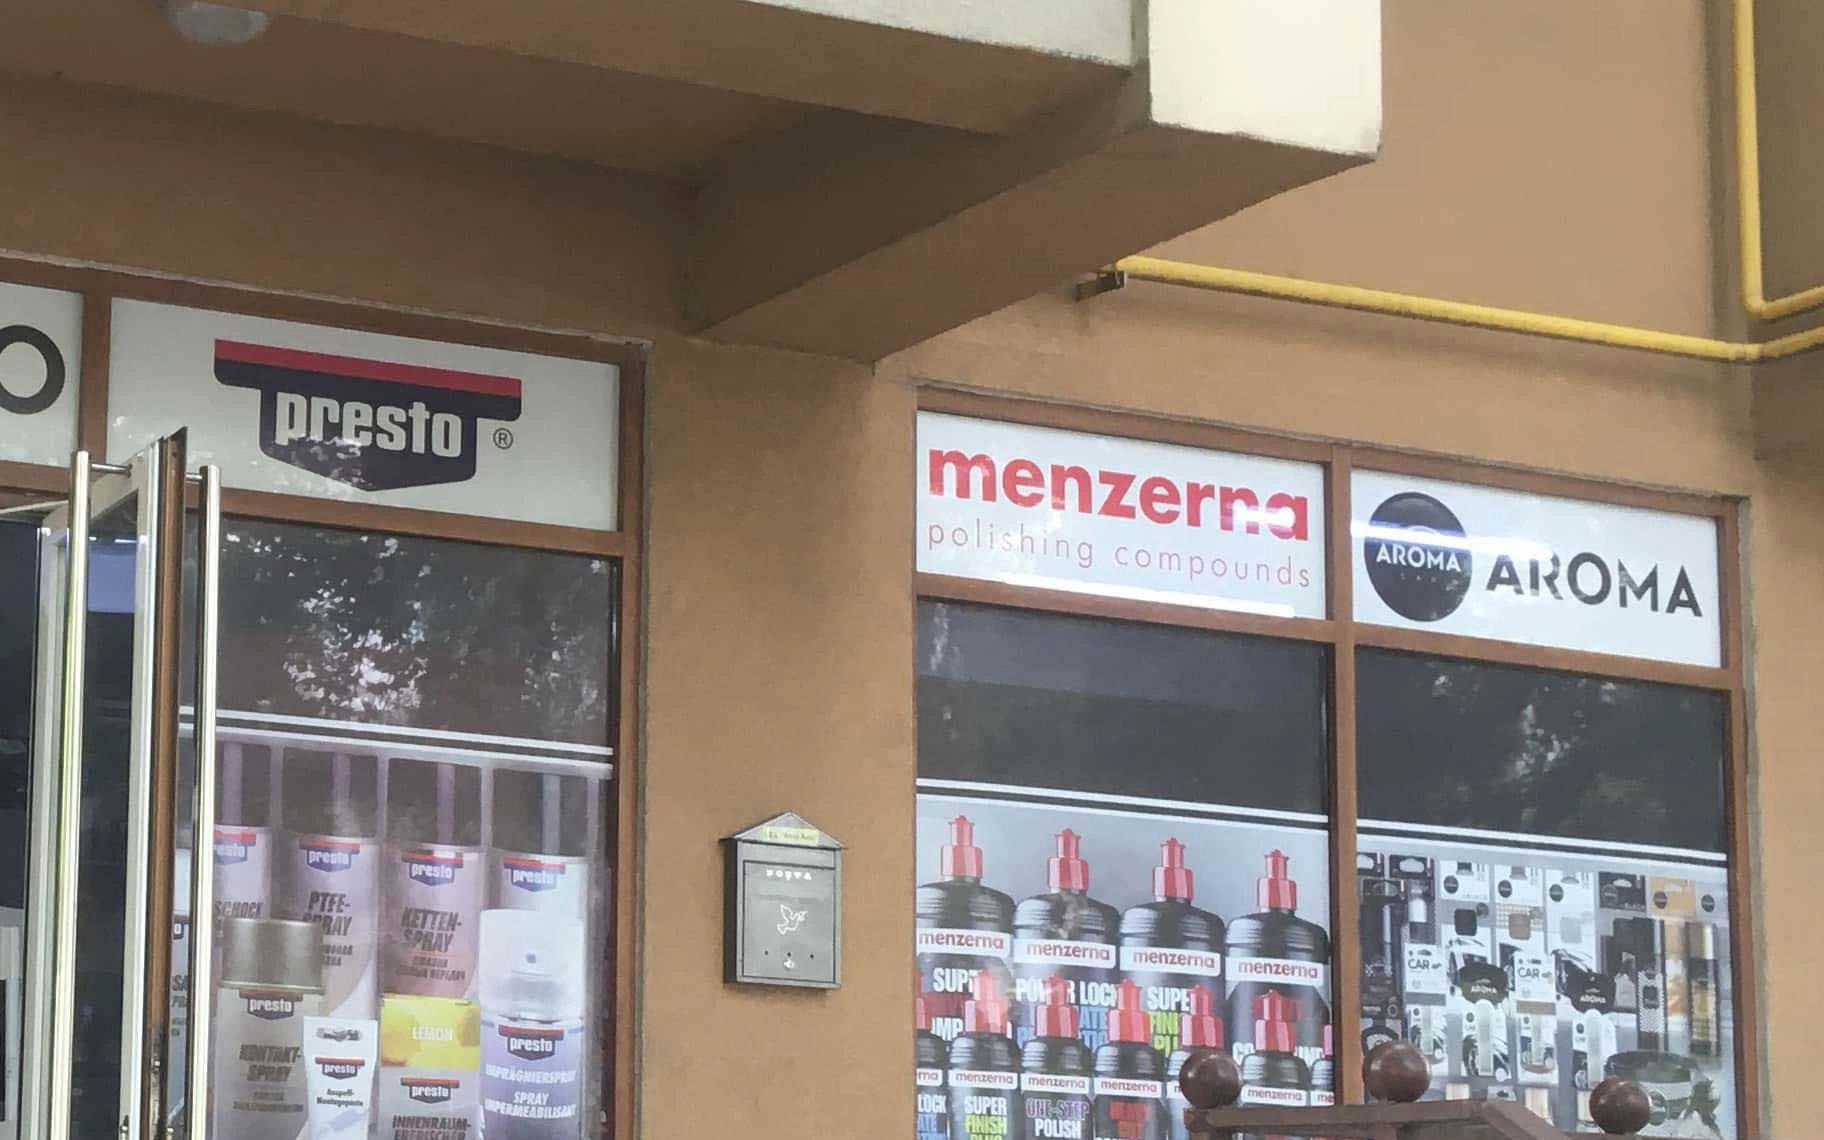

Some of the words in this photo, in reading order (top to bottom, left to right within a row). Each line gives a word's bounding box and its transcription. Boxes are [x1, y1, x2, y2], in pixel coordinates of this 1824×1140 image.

[275, 391, 462, 458] presto
[928, 448, 1309, 542] menzerna
[928, 518, 1093, 568] polishing
[1115, 543, 1309, 588] compounds
[1375, 543, 1461, 573] AROMA
[1486, 551, 1703, 617] AROMA
[308, 851, 350, 866] presto
[410, 862, 453, 880] presto
[512, 868, 556, 886] presto
[404, 928, 454, 953] SPRAY
[919, 932, 1004, 949] menzerna
[1026, 943, 1110, 960] menzerna
[1133, 950, 1215, 969] menzerna
[1238, 961, 1318, 978] menzerna
[1408, 958, 1430, 970] CAR
[1518, 967, 1540, 978] CAR
[249, 998, 292, 1013] presto
[1146, 986, 1191, 1011] SUPE
[412, 1025, 454, 1041] LEMON
[509, 1037, 553, 1054] presto
[324, 1063, 356, 1075] presto
[955, 1071, 1014, 1085] menzerna
[1028, 1075, 1086, 1089] menzerna
[1101, 1080, 1158, 1093] menzerna
[411, 1085, 449, 1099] presto
[513, 1091, 550, 1106] SPRAY
[1248, 1088, 1303, 1101] menzerna
[918, 1094, 947, 1114] LOCK
[964, 1095, 1007, 1115] SUPER
[1026, 1097, 1090, 1120] ONE-STEP
[965, 1115, 1008, 1135] FINISH
[1035, 1118, 1082, 1139] POLISH
